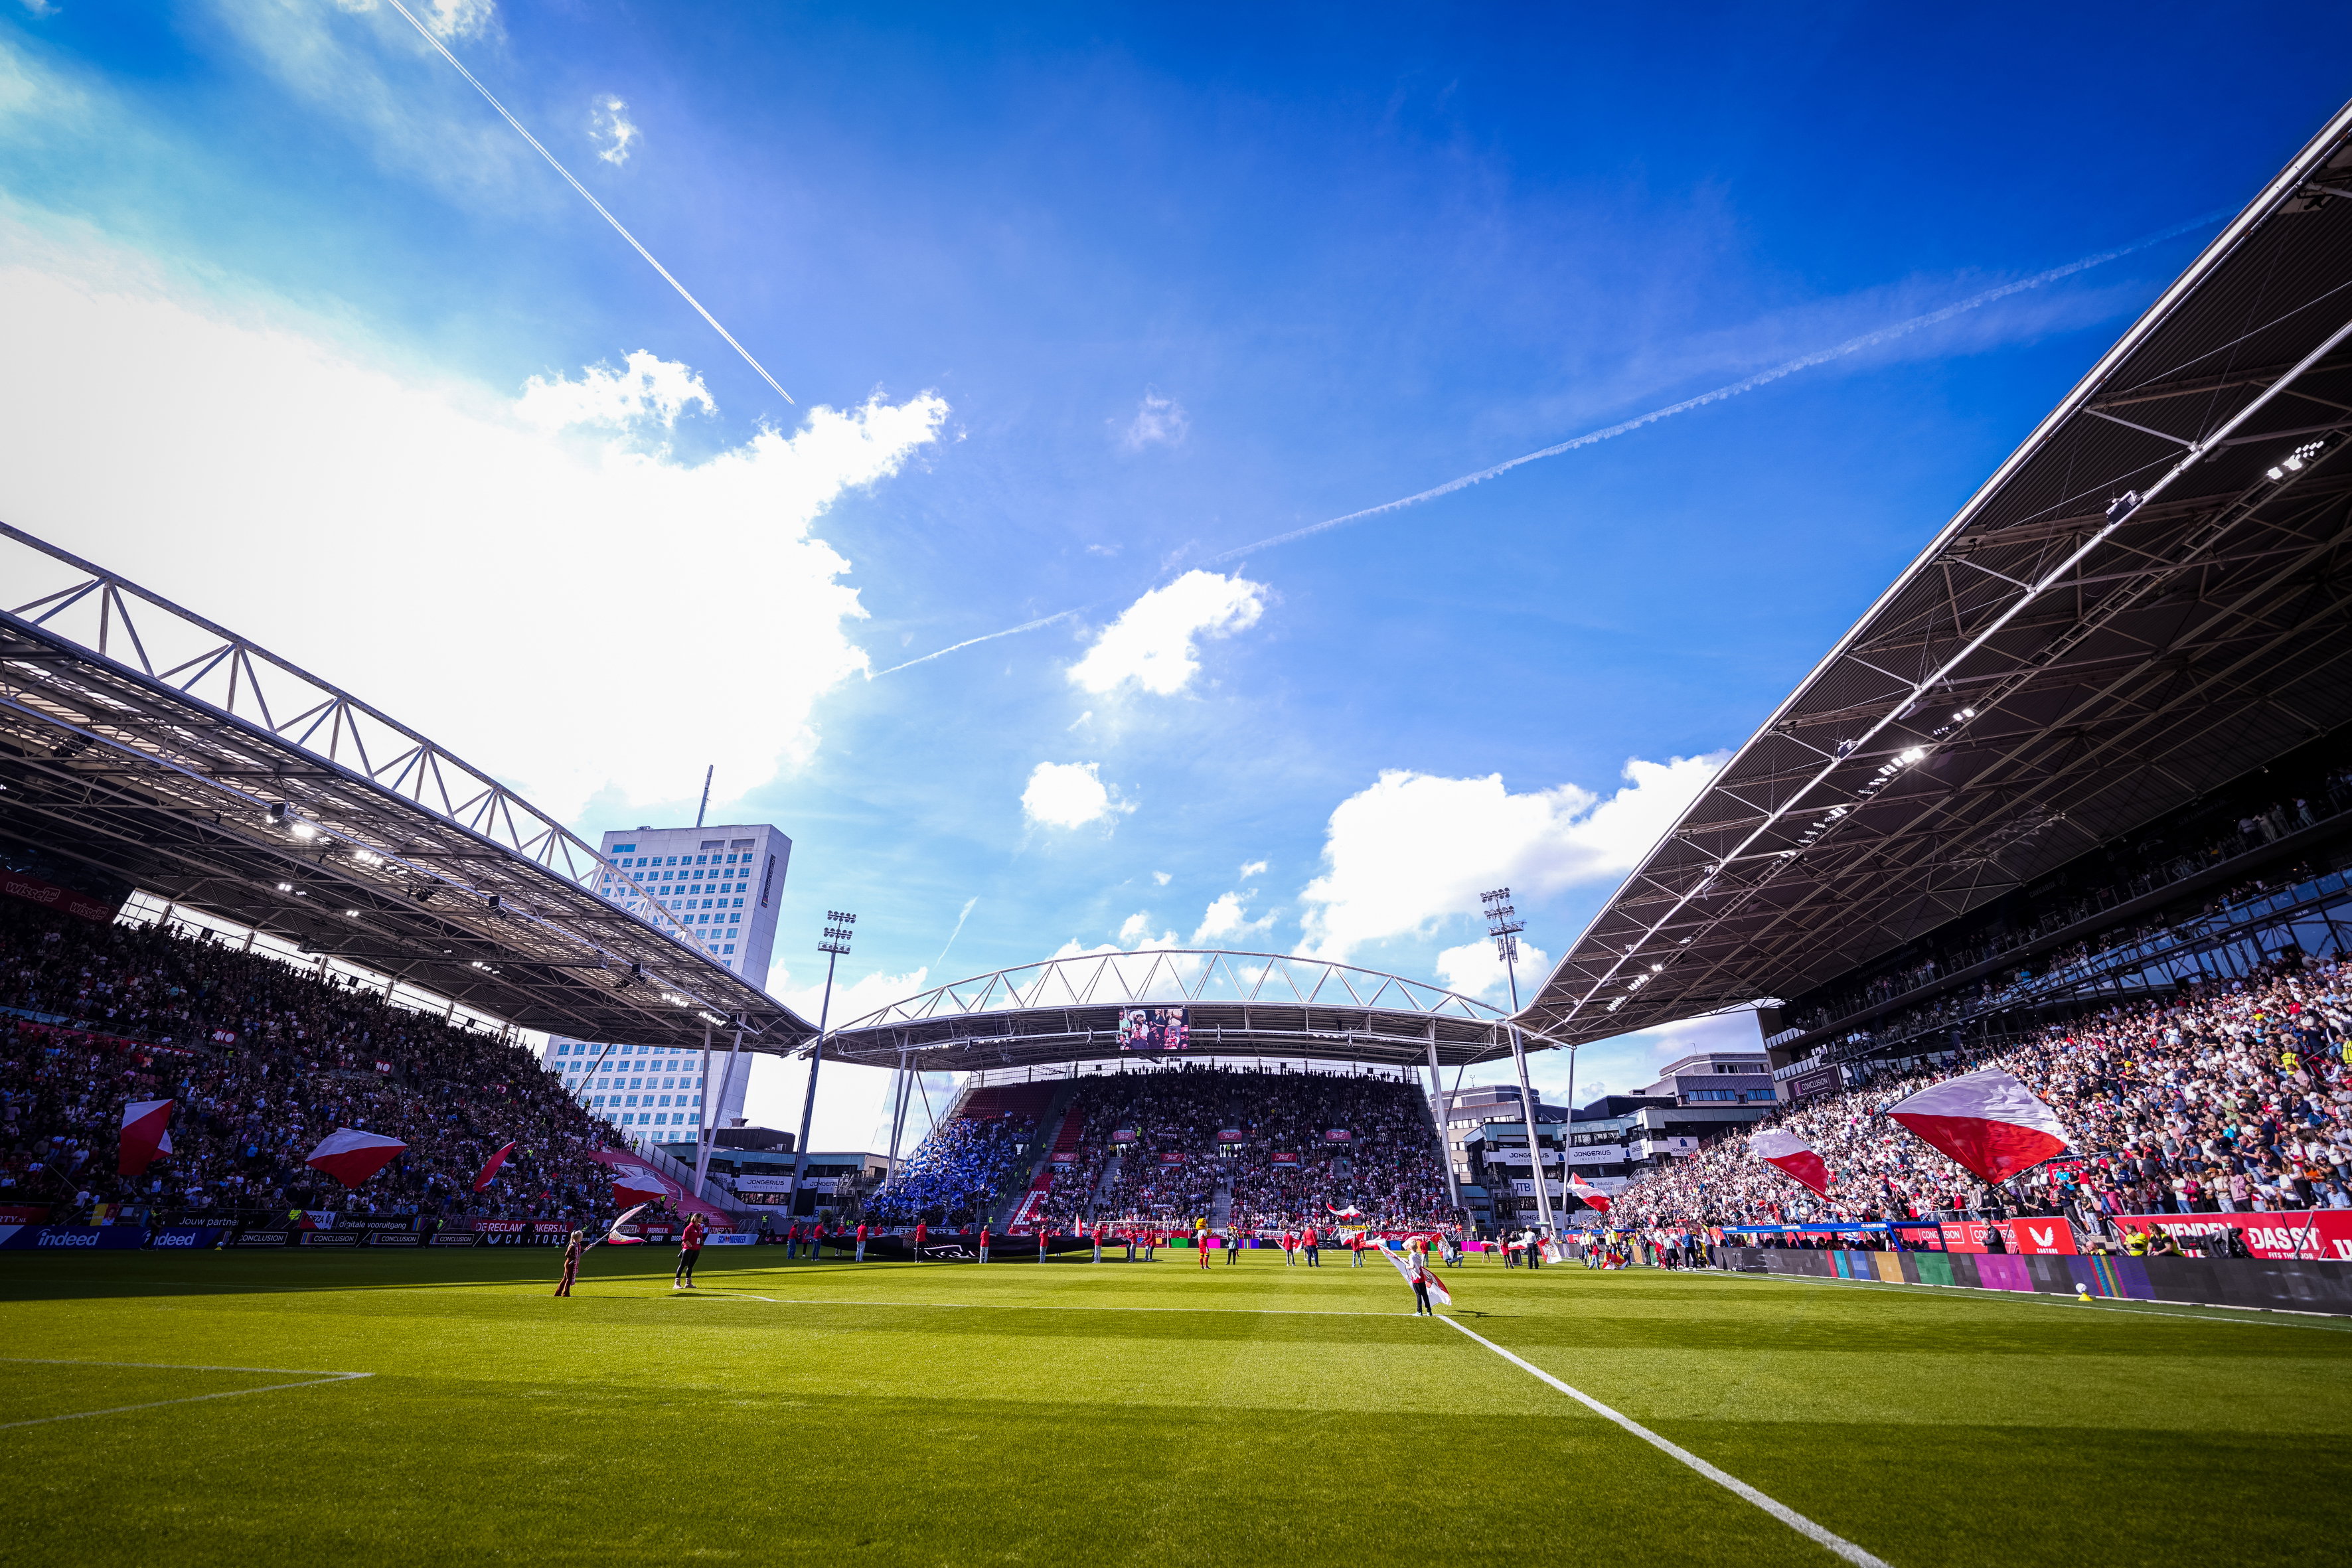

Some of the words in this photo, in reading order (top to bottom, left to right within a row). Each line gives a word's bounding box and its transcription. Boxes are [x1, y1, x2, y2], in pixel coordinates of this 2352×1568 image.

[1802, 1077, 1828, 1091] CONCLUSION
[179, 1217, 204, 1226] Jouw
[339, 1219, 366, 1229] digitale
[366, 1221, 407, 1230] vooruitgang
[475, 1223, 488, 1231] DE
[36, 1229, 100, 1247] indeed
